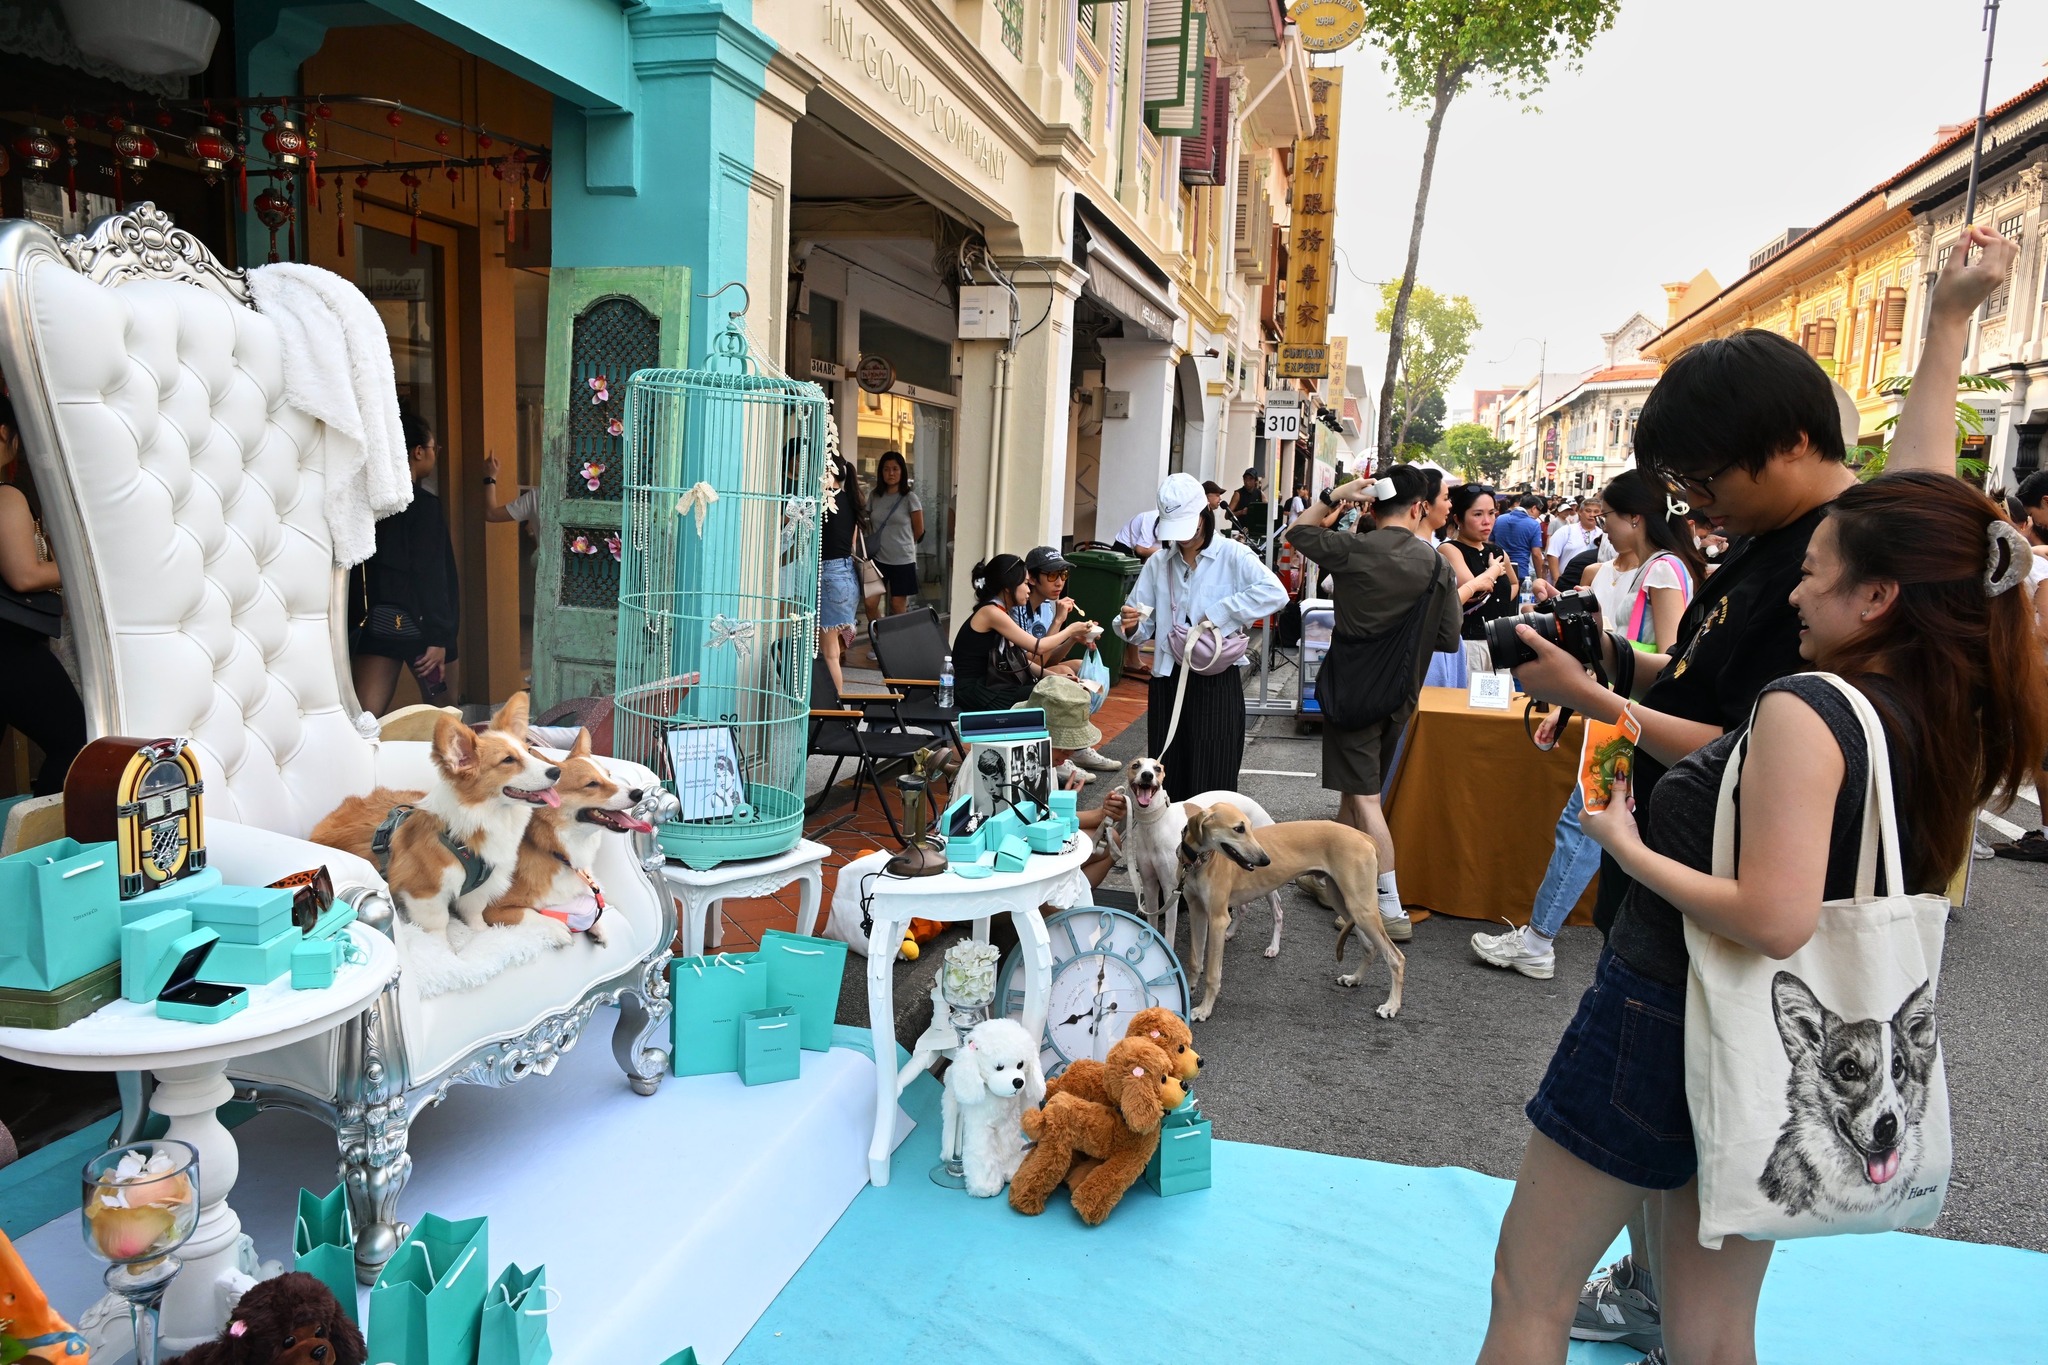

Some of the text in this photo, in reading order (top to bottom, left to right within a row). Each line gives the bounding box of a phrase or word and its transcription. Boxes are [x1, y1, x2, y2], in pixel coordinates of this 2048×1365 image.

[829, 0, 1008, 184] IN GOOD COMPANY
[1283, 348, 1325, 359] CURTAIN
[811, 361, 836, 376] 314ABC
[1284, 362, 1321, 373] EXPERT
[907, 385, 916, 396] 314
[1268, 416, 1296, 432] 310
[1095, 911, 1115, 953] 2
[1126, 928, 1155, 965] 3
[1907, 1185, 1938, 1200] Haru
[1599, 1303, 1626, 1325] N
